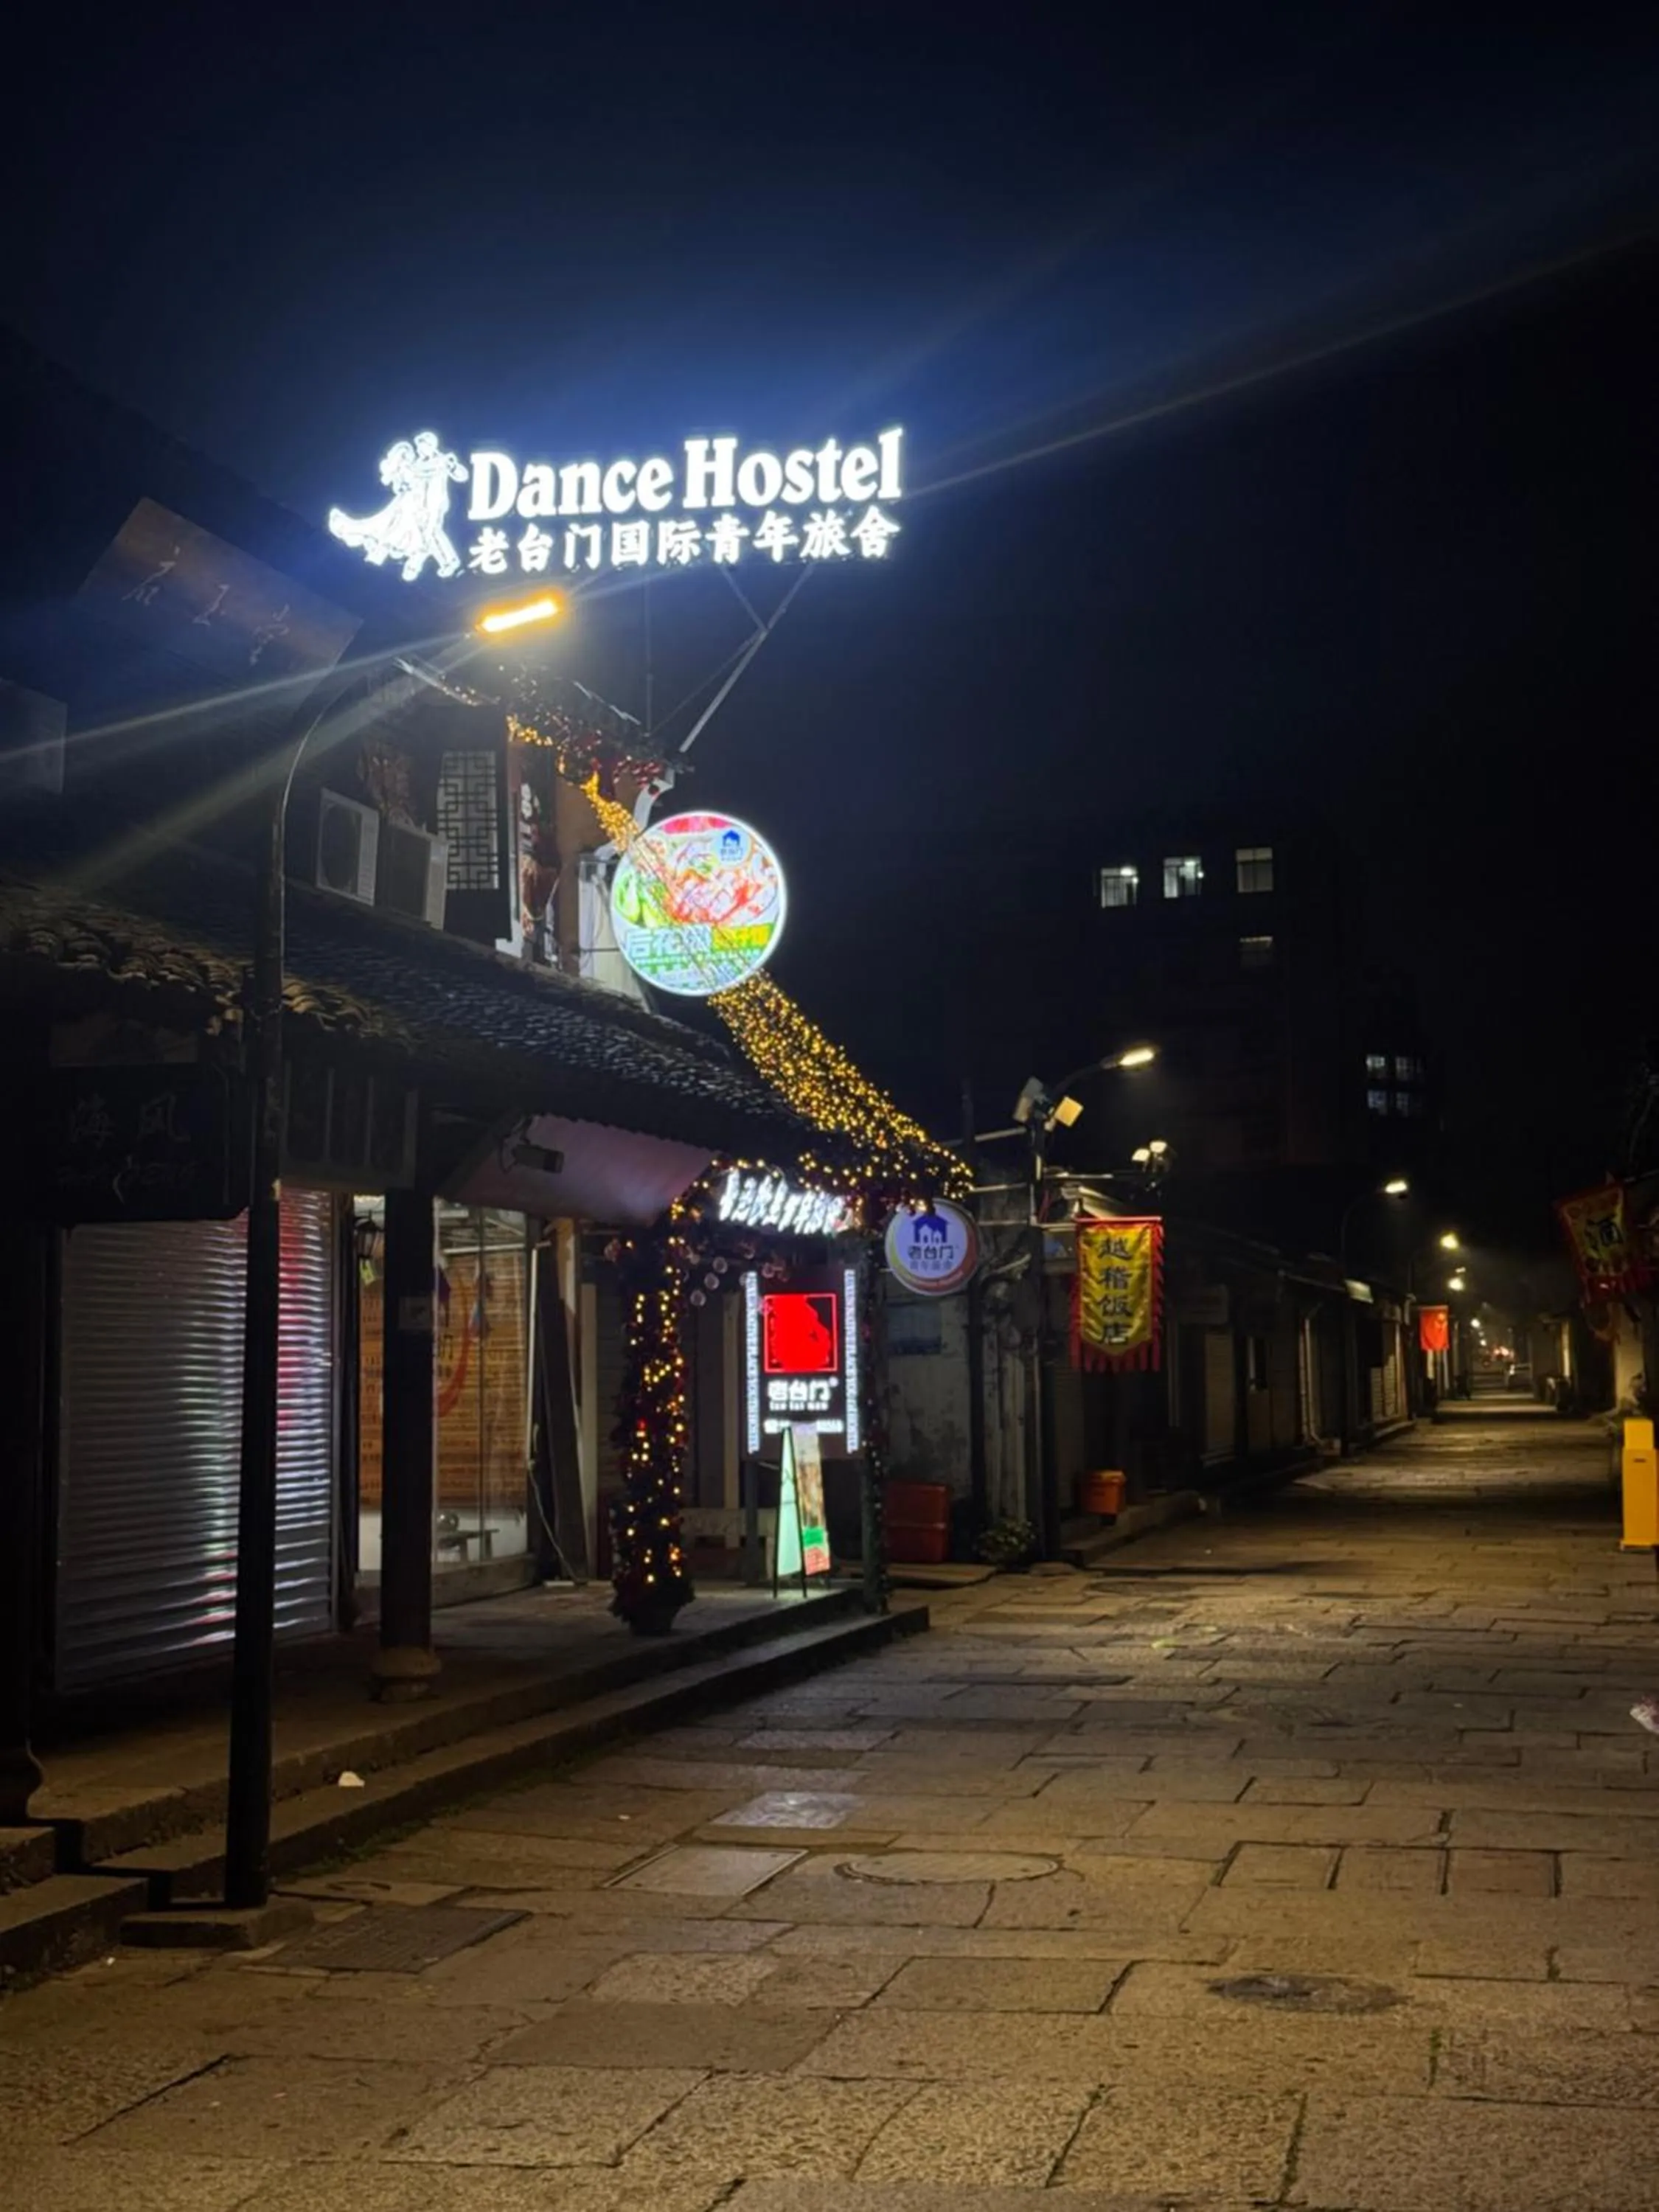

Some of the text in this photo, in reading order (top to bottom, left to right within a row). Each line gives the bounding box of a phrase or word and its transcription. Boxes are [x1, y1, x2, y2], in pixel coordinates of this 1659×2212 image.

[467, 428, 905, 521] Dance Hostel
[466, 506, 901, 574] 老台门国际青年旅舍
[908, 1245, 955, 1259] 老台门
